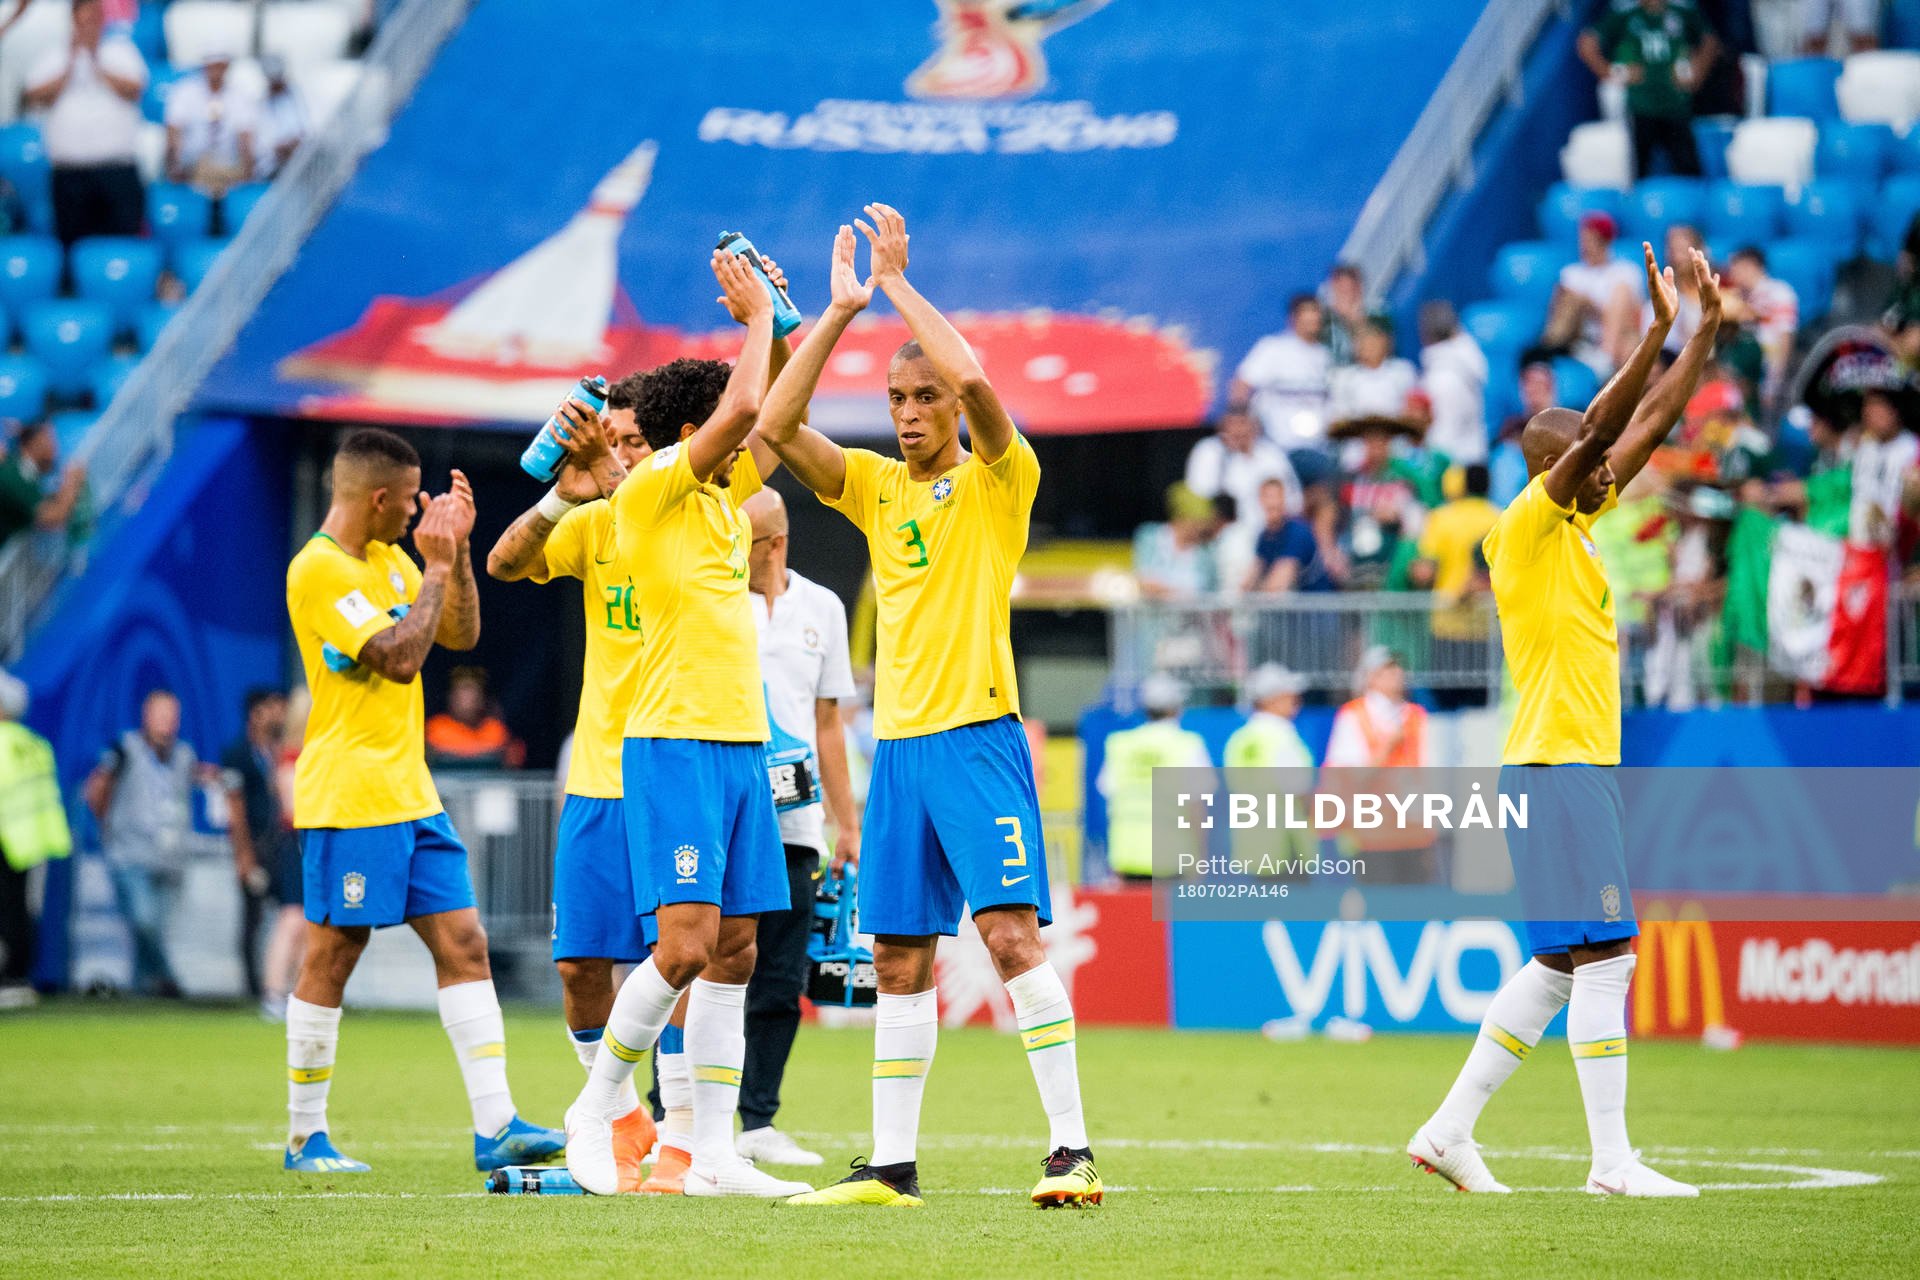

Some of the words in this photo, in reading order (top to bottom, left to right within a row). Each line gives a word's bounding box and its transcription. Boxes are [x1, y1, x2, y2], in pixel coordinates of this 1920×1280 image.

[897, 519, 929, 568] 3
[606, 585, 641, 630] 20
[995, 816, 1027, 866] 3
